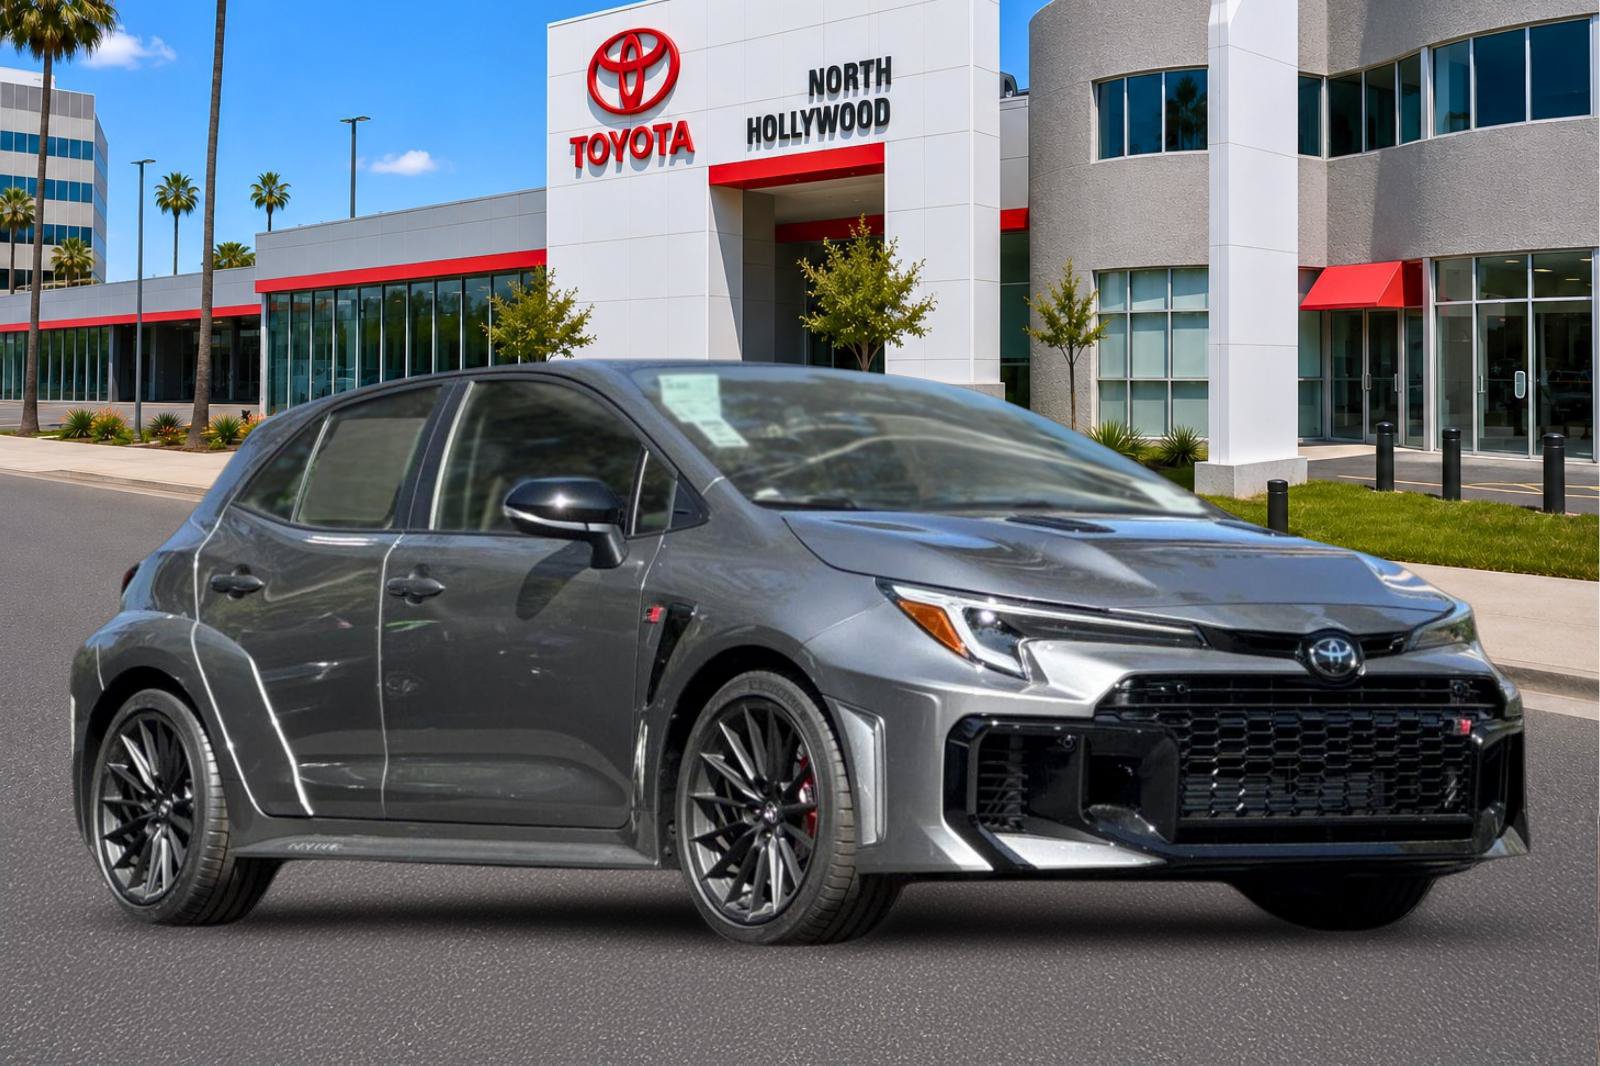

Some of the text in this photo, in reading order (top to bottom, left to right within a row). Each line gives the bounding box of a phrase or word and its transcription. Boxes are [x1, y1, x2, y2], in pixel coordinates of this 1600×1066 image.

[809, 56, 892, 97] NORTH
[570, 120, 695, 169] TOYOTA
[747, 97, 891, 145] HOLLYWOOD
